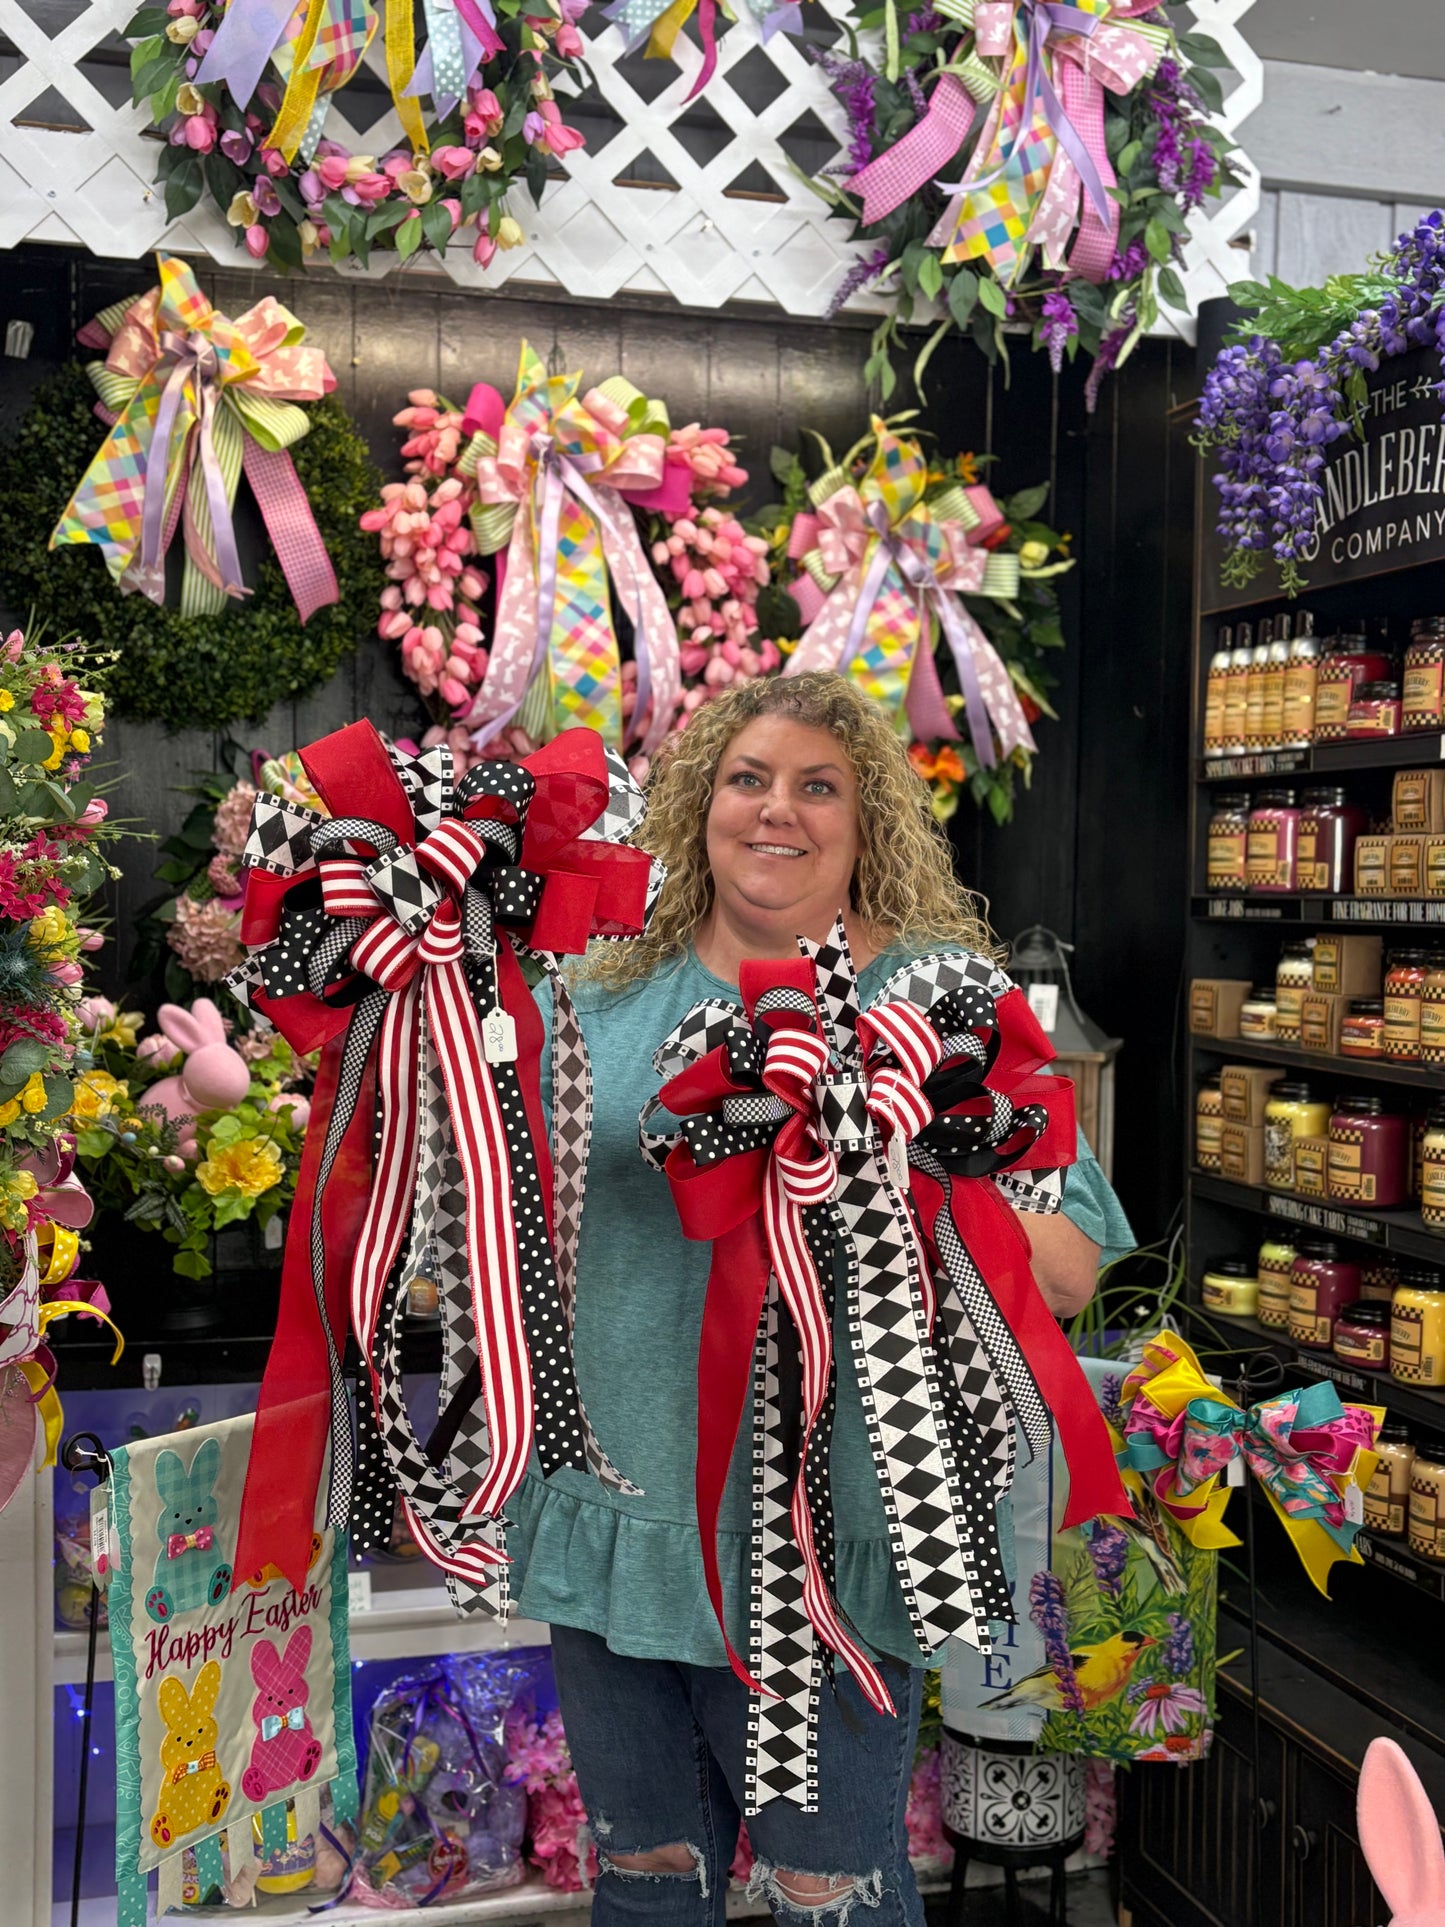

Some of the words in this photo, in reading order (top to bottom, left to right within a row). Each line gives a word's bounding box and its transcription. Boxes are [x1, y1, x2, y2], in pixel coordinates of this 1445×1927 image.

[1371, 380, 1407, 416] THE
[1331, 509, 1445, 564] COMPANY
[1332, 900, 1350, 920] FINE
[1350, 901, 1392, 921] FRAGRANCE
[1392, 902, 1408, 922] FOR
[1408, 902, 1424, 922] THE
[144, 1622, 240, 1680] Happy
[239, 1583, 322, 1636] Easter
